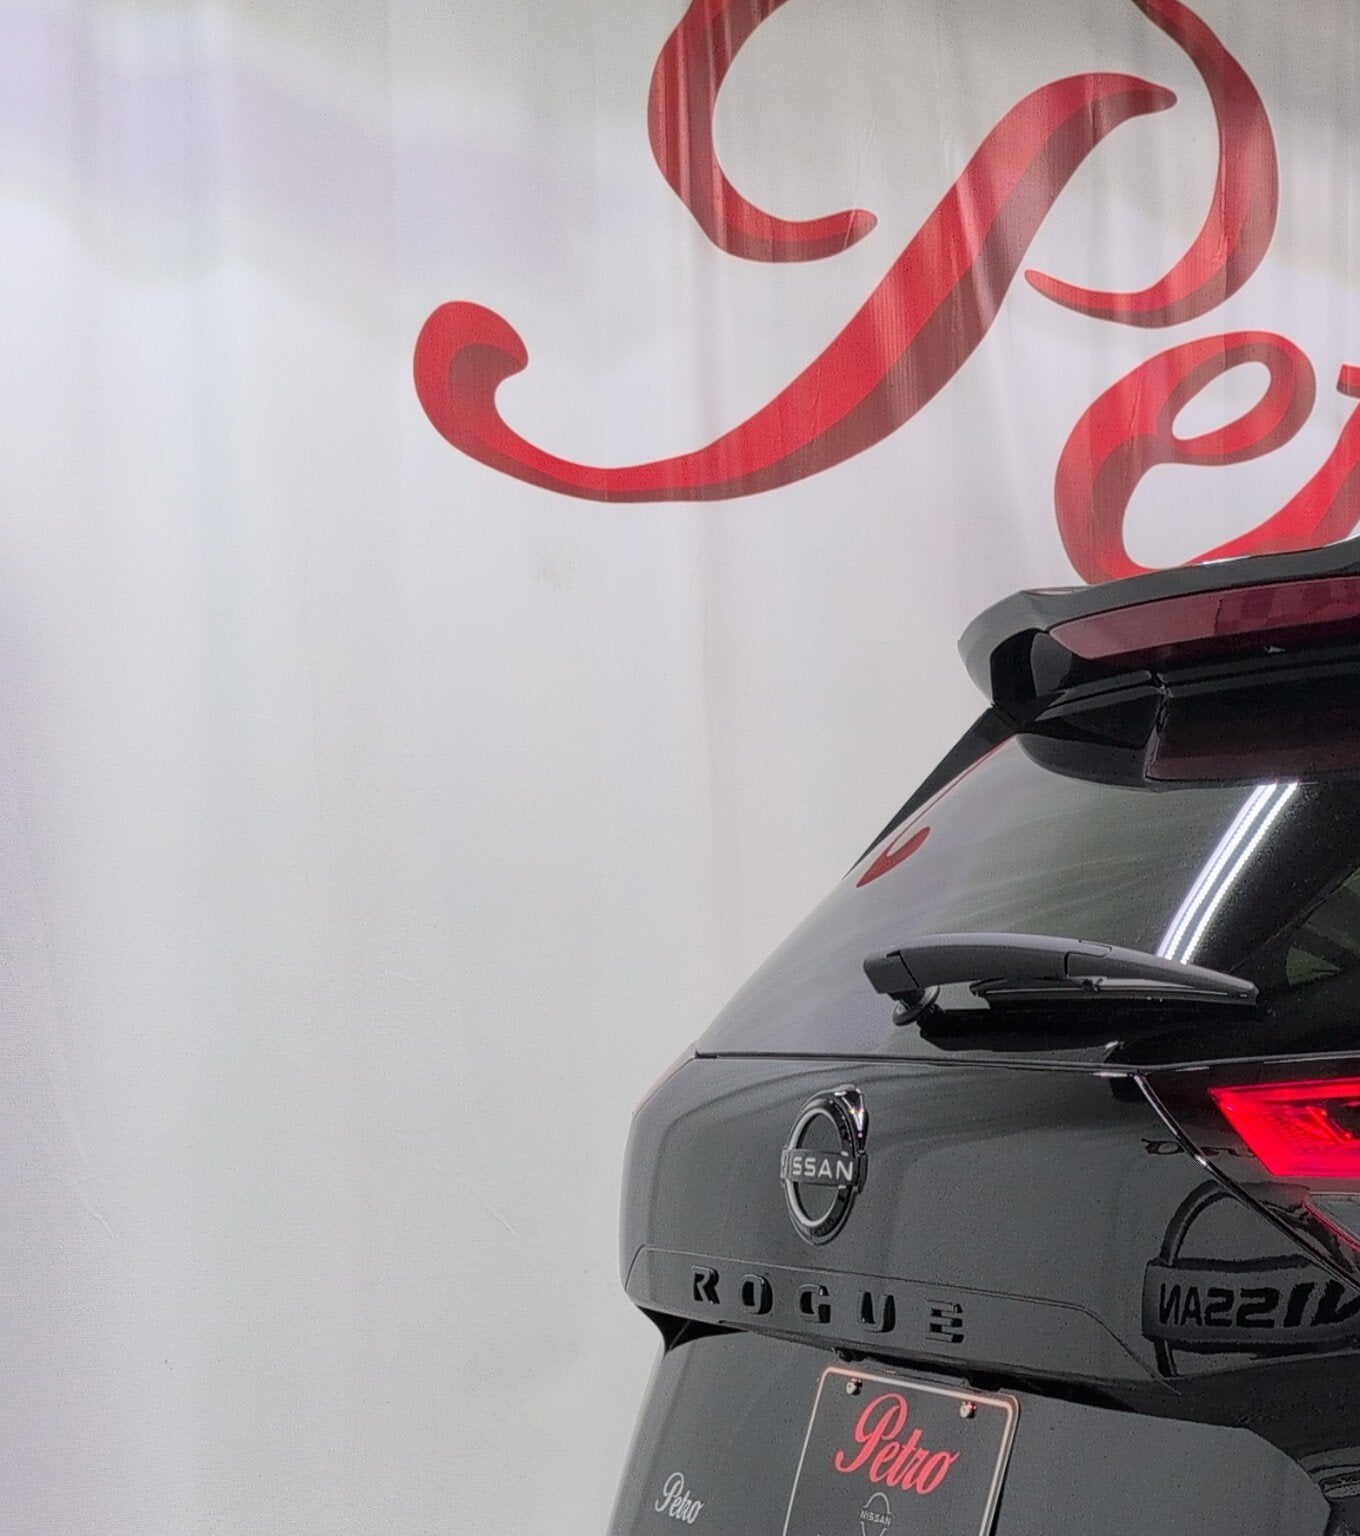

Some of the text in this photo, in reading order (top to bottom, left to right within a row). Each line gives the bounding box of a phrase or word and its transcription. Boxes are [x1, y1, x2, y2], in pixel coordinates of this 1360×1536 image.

[792, 1155, 854, 1182] SSAN
[690, 1264, 966, 1344] ROGUE
[834, 1393, 961, 1495] Petro
[655, 1471, 705, 1525] Petro
[860, 1508, 893, 1526] NISSAN
